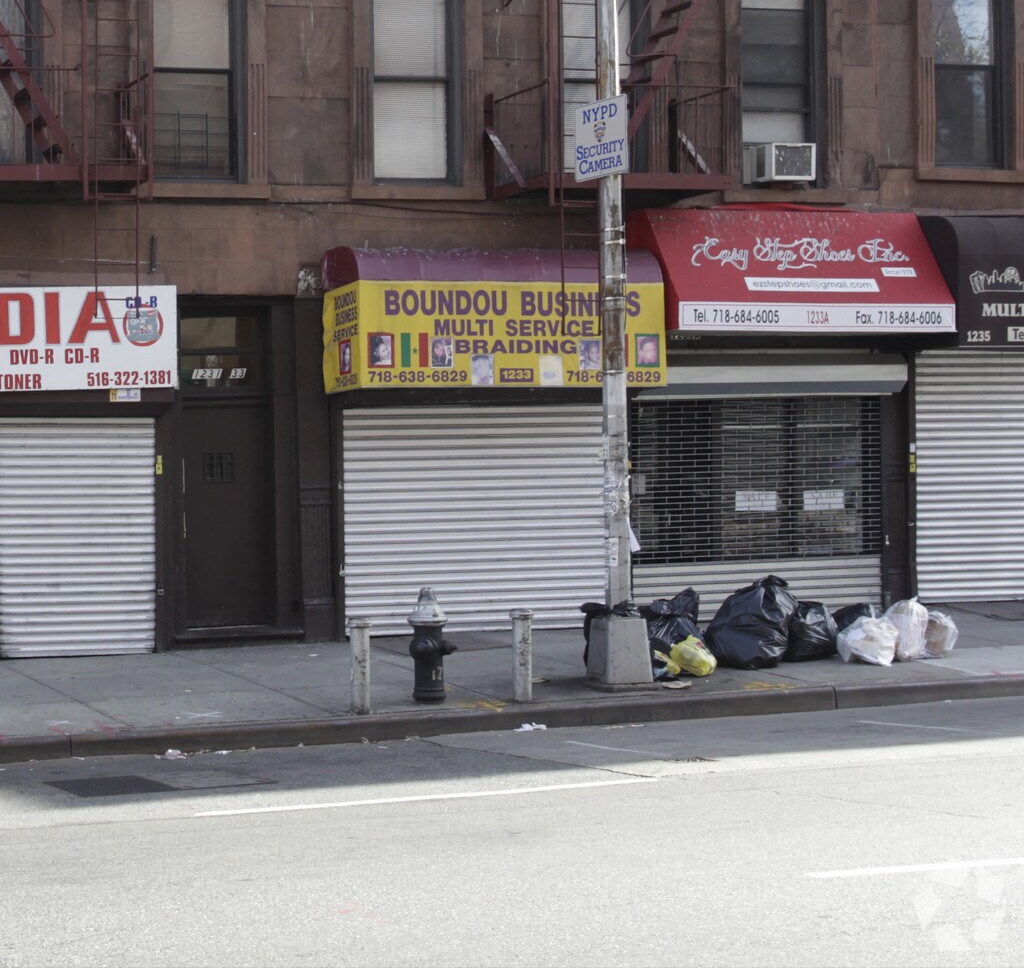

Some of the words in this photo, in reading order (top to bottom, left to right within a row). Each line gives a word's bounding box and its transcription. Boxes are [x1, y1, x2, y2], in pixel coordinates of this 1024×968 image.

[582, 103, 618, 125] NYPD
[576, 139, 624, 161] SECURITY
[579, 155, 623, 175] CAMERA
[691, 236, 749, 271] Easy
[753, 237, 807, 271] Step
[799, 236, 856, 263] Shoes
[857, 238, 910, 263] Inc.
[752, 280, 873, 291] ezstepshoes@gmail.com
[385, 289, 507, 316] BOUNDOU
[521, 290, 641, 317] BUSINS
[693, 309, 710, 323] Tel.
[713, 309, 780, 324] 718-684-6005
[806, 311, 830, 324] 1233A
[856, 312, 874, 325] Fax.
[878, 311, 943, 325] 718-684-6006
[333, 324, 358, 342] SERVICE
[434, 319, 494, 336] MULTI
[967, 331, 991, 342] 1235
[455, 339, 577, 354] BRAIDING
[10, 348, 54, 365] DVD-R
[64, 347, 99, 364] CD-R
[87, 370, 172, 387] 516-322-1381
[195, 369, 221, 378] 1231
[368, 370, 468, 383] 718-638-6829
[502, 370, 532, 380] 1233
